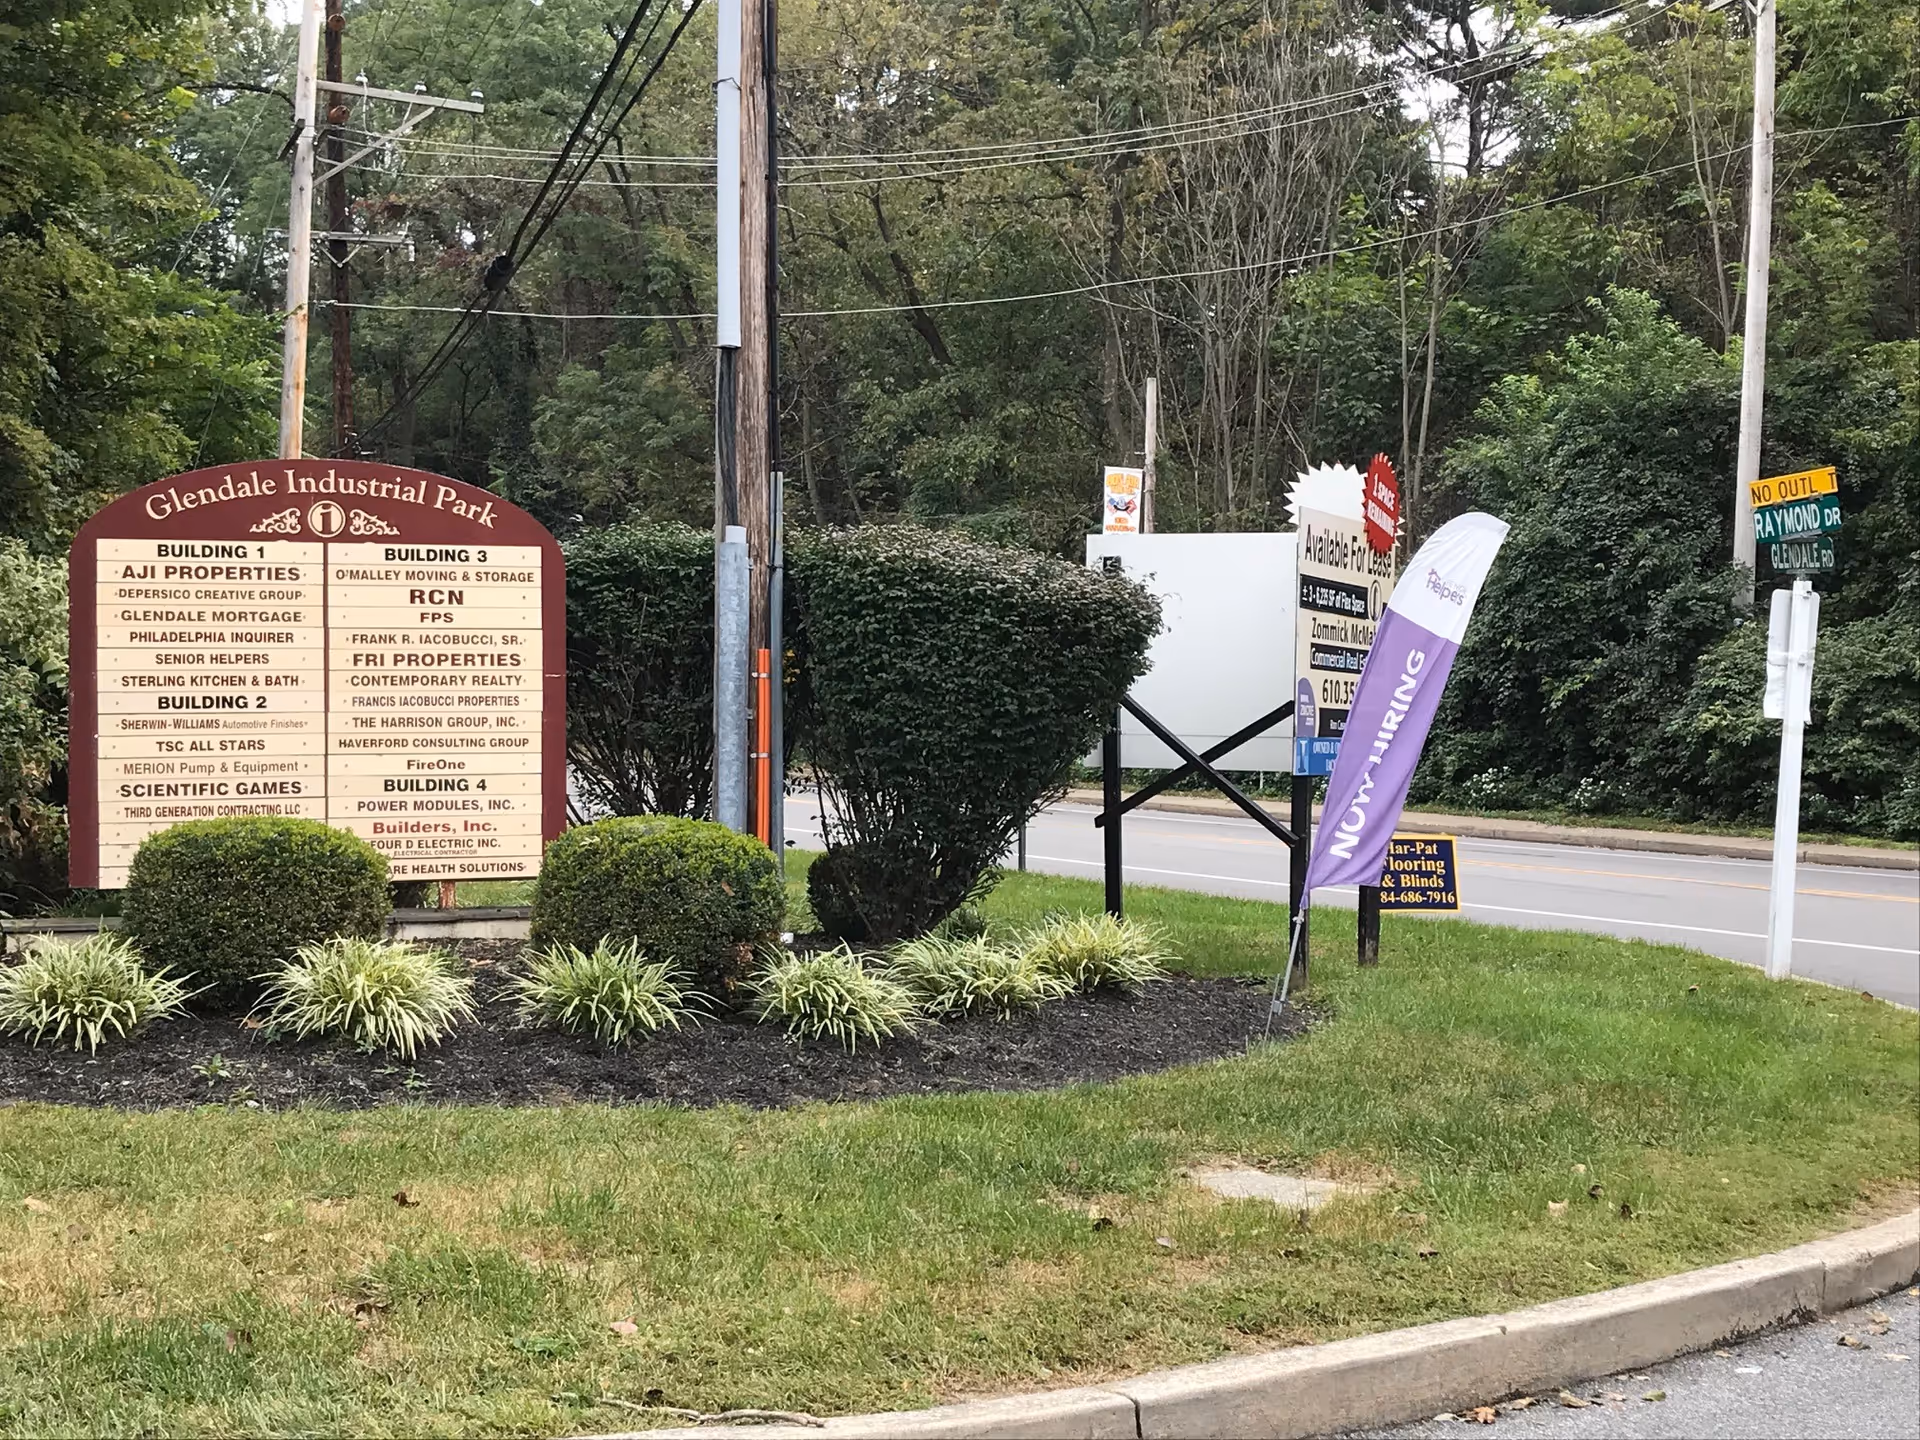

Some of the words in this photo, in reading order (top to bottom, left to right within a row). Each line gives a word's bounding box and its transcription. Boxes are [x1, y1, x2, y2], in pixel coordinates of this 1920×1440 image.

[1751, 485, 1771, 504] NO
[1778, 472, 1836, 498] OUTLT
[145, 471, 278, 520] Glendale
[284, 469, 427, 503] Industrial
[433, 484, 498, 528] Park
[1754, 503, 1820, 539] RAYMOND
[1824, 507, 1841, 527] DR
[158, 544, 247, 558] BUILDING
[257, 546, 264, 558] 1
[385, 548, 470, 562] BUILDING
[477, 551, 488, 563] 3
[1305, 524, 1348, 569] Available
[1351, 535, 1366, 573] For
[1368, 543, 1391, 579] Lease
[1771, 543, 1820, 569] GLENDALE
[1822, 549, 1834, 567] RD
[122, 565, 155, 579] AJI
[165, 566, 300, 581] PROPERTIES
[336, 569, 401, 580] O'MALLEY
[406, 571, 457, 581] MOVING
[462, 571, 470, 581] &
[475, 572, 534, 582] STORAGE
[119, 589, 190, 599] DEPERSICO
[195, 590, 255, 600] CREATIVE
[259, 590, 302, 600] GROUP
[410, 589, 463, 605] RCN
[121, 610, 206, 621] GLENDALE
[212, 611, 302, 622] MORTGAGE
[421, 613, 453, 623] FPS
[1312, 617, 1349, 642] Zommick
[130, 632, 225, 642] PHILADELPHIA
[231, 632, 293, 643] INQUIRER
[352, 634, 397, 644] FRANK
[402, 634, 414, 644] R.
[420, 634, 497, 646] IACOBUCCI,
[502, 635, 522, 645] SR.
[156, 654, 204, 664] SENIOR
[210, 654, 269, 664] HELPERS
[353, 654, 384, 666] FRI
[394, 653, 521, 666] PROPERTIES
[1311, 648, 1345, 668] Commercial
[1346, 652, 1358, 669] Real
[1359, 653, 1368, 671] Es
[122, 676, 185, 686] STERLING
[191, 675, 246, 686] KITCHEN
[252, 675, 259, 686] &
[265, 676, 298, 686] BATH
[351, 675, 466, 686] CONTEMPORARY
[472, 675, 522, 685] REALTY
[1322, 679, 1358, 704] 610.35
[158, 696, 248, 709] BUILDING
[256, 696, 267, 708] 2
[352, 696, 396, 707] FRANCIS
[400, 696, 454, 706] IACOBUCCI
[458, 696, 519, 706] PROPERTIES
[121, 719, 220, 730] SHERWIN-WILLIAMS
[222, 720, 267, 729] Automotive
[271, 719, 304, 729] Finishes
[352, 717, 376, 728] THE
[381, 717, 443, 728] HARRISON
[447, 717, 493, 730] GROUP,
[496, 717, 519, 728] INC.
[156, 741, 183, 751] TSC
[190, 741, 214, 751] ALL
[219, 740, 265, 751] STARS
[339, 739, 408, 748] HAVERFORD
[413, 738, 485, 747] CONSULTING
[490, 738, 529, 747] GROUP
[1329, 772, 1374, 859] NOW
[1369, 649, 1425, 765] HIRING
[124, 763, 174, 774] MERION
[180, 763, 215, 775] Pump
[220, 762, 228, 773] &
[234, 761, 298, 775] Equipment
[407, 759, 465, 770] FireOne
[121, 783, 228, 796] SCIENTIFIC
[236, 781, 301, 795] GAMES
[384, 779, 469, 792] BUILDING
[477, 779, 487, 791] 4
[124, 807, 151, 818] THIRD
[155, 806, 214, 817] GENERATION
[217, 804, 282, 816] CONTRACTING
[285, 804, 300, 815] LLC
[358, 801, 407, 811] POWER
[414, 800, 483, 812] MODULES,
[489, 799, 514, 810] INC.
[373, 821, 456, 834] Builders,
[464, 820, 497, 831] Inc.
[371, 840, 402, 850] FOUR
[406, 840, 413, 849] D
[418, 839, 473, 848] ELECTRIC
[478, 838, 500, 847] INC.
[388, 864, 408, 875] ARE
[412, 864, 455, 874] HEALTH
[460, 863, 523, 873] SOLUTIONS
[1382, 874, 1395, 888] &
[1400, 874, 1444, 888] Blinds
[1380, 891, 1455, 903] 84-686-7916
